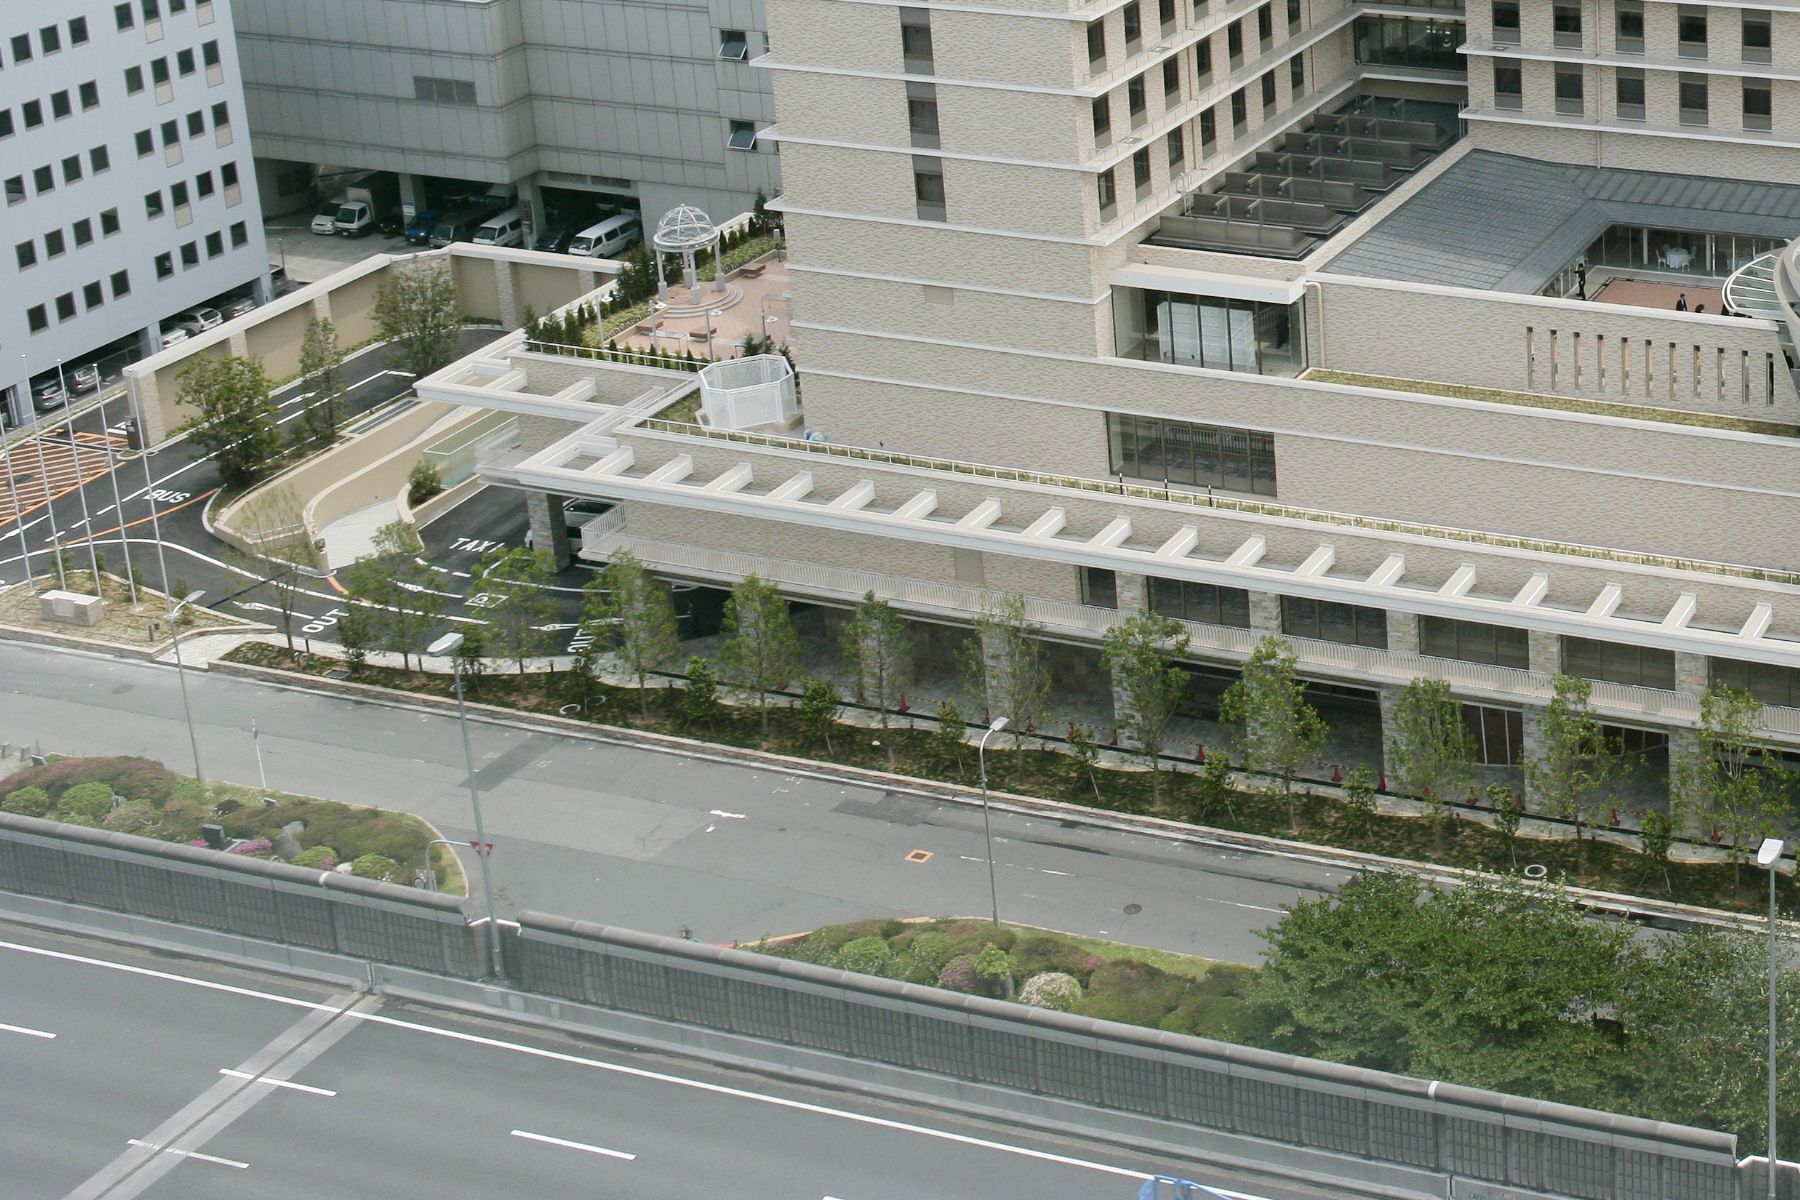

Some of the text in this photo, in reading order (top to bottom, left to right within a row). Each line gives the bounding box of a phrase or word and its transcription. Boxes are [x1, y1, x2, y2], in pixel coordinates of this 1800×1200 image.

[142, 489, 191, 504] BUS
[449, 537, 505, 554] TAXI
[302, 608, 350, 633] OUT
